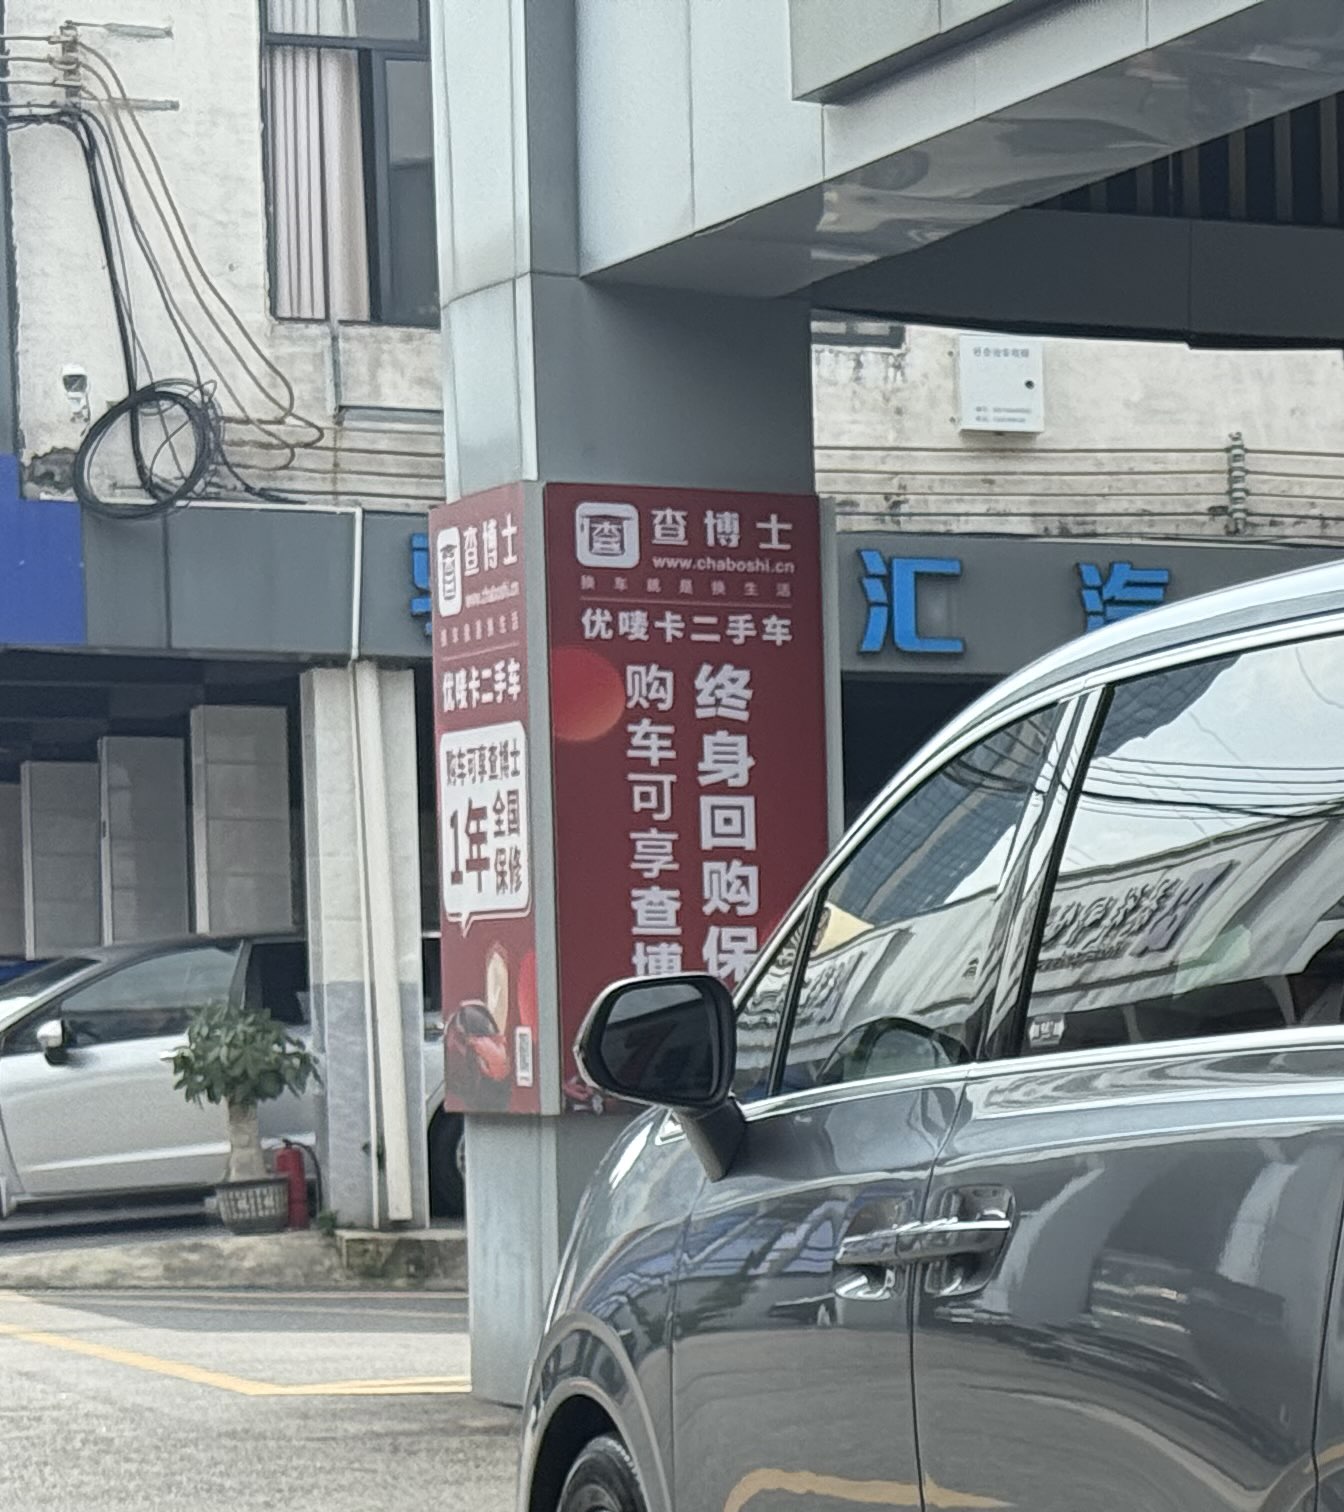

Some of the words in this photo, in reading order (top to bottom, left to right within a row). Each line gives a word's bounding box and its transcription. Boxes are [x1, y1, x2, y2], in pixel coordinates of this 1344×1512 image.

[463, 512, 519, 577] 查博士
[650, 507, 794, 552] 查博士
[652, 555, 796, 574] www.chaboshi.cn
[580, 607, 793, 647] 优唛卡二手车
[449, 797, 491, 893] 1年
